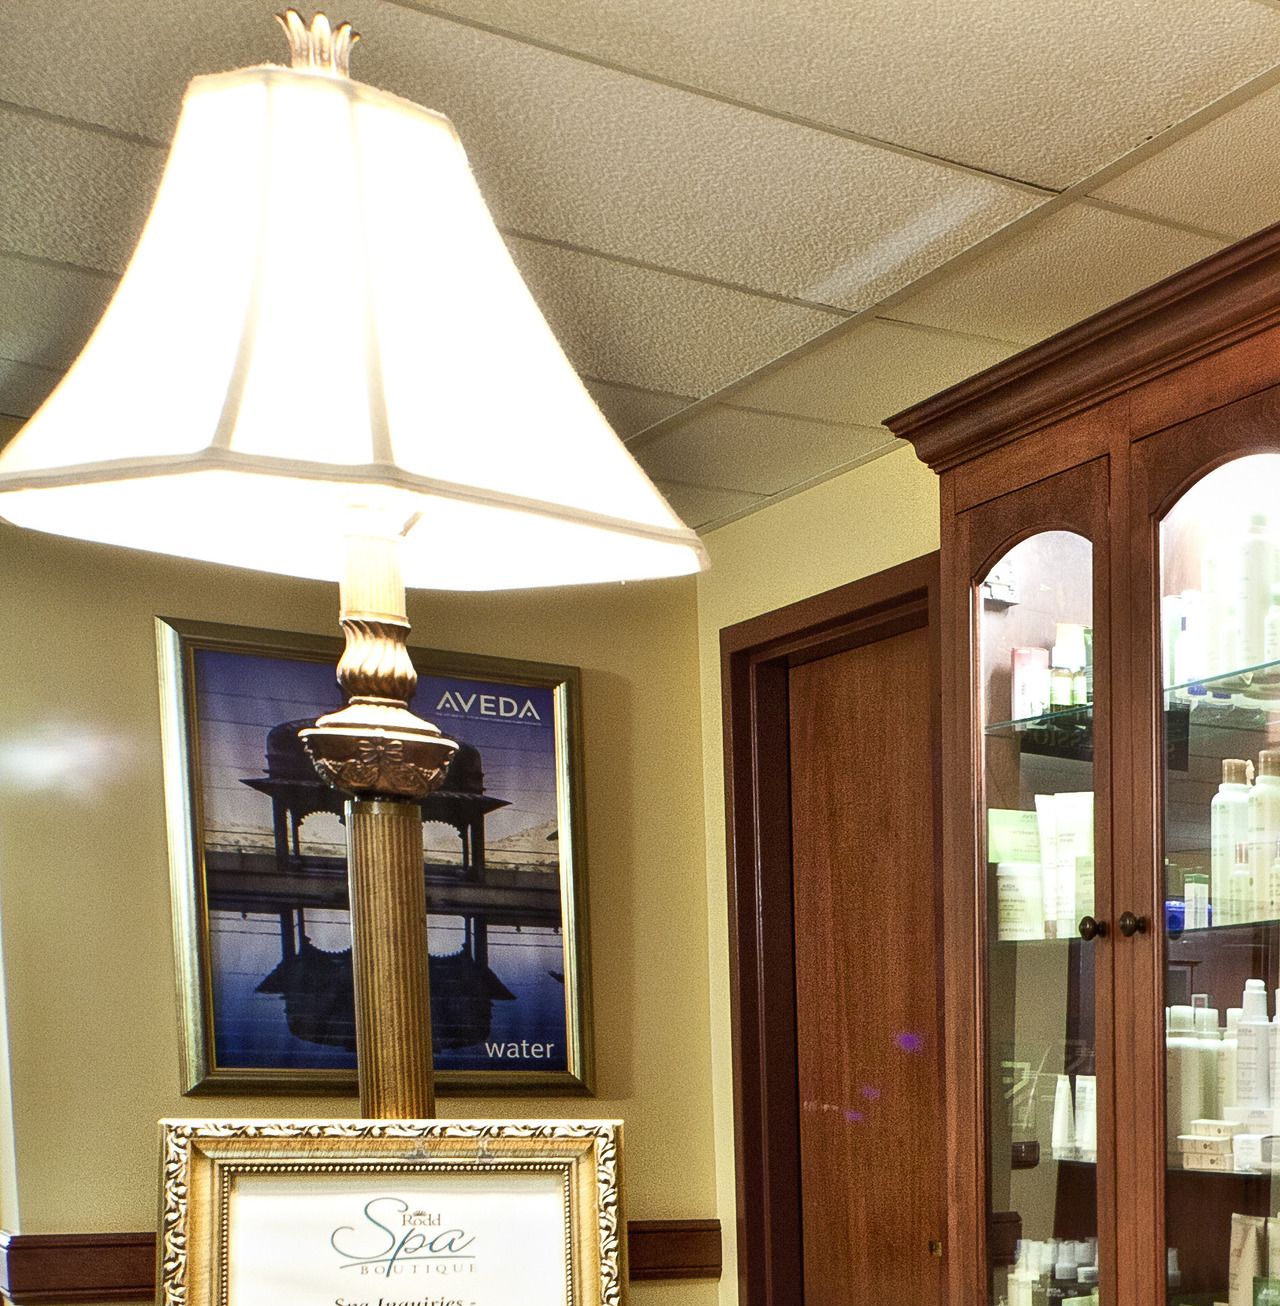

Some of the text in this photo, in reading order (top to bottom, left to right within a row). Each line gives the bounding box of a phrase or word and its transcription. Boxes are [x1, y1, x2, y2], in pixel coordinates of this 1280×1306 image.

[436, 690, 541, 721] AVEDA
[484, 1039, 554, 1059] water
[402, 1213, 441, 1226] Rodd
[330, 1197, 476, 1278] Spa
[360, 1263, 478, 1276] BOUTIQUE
